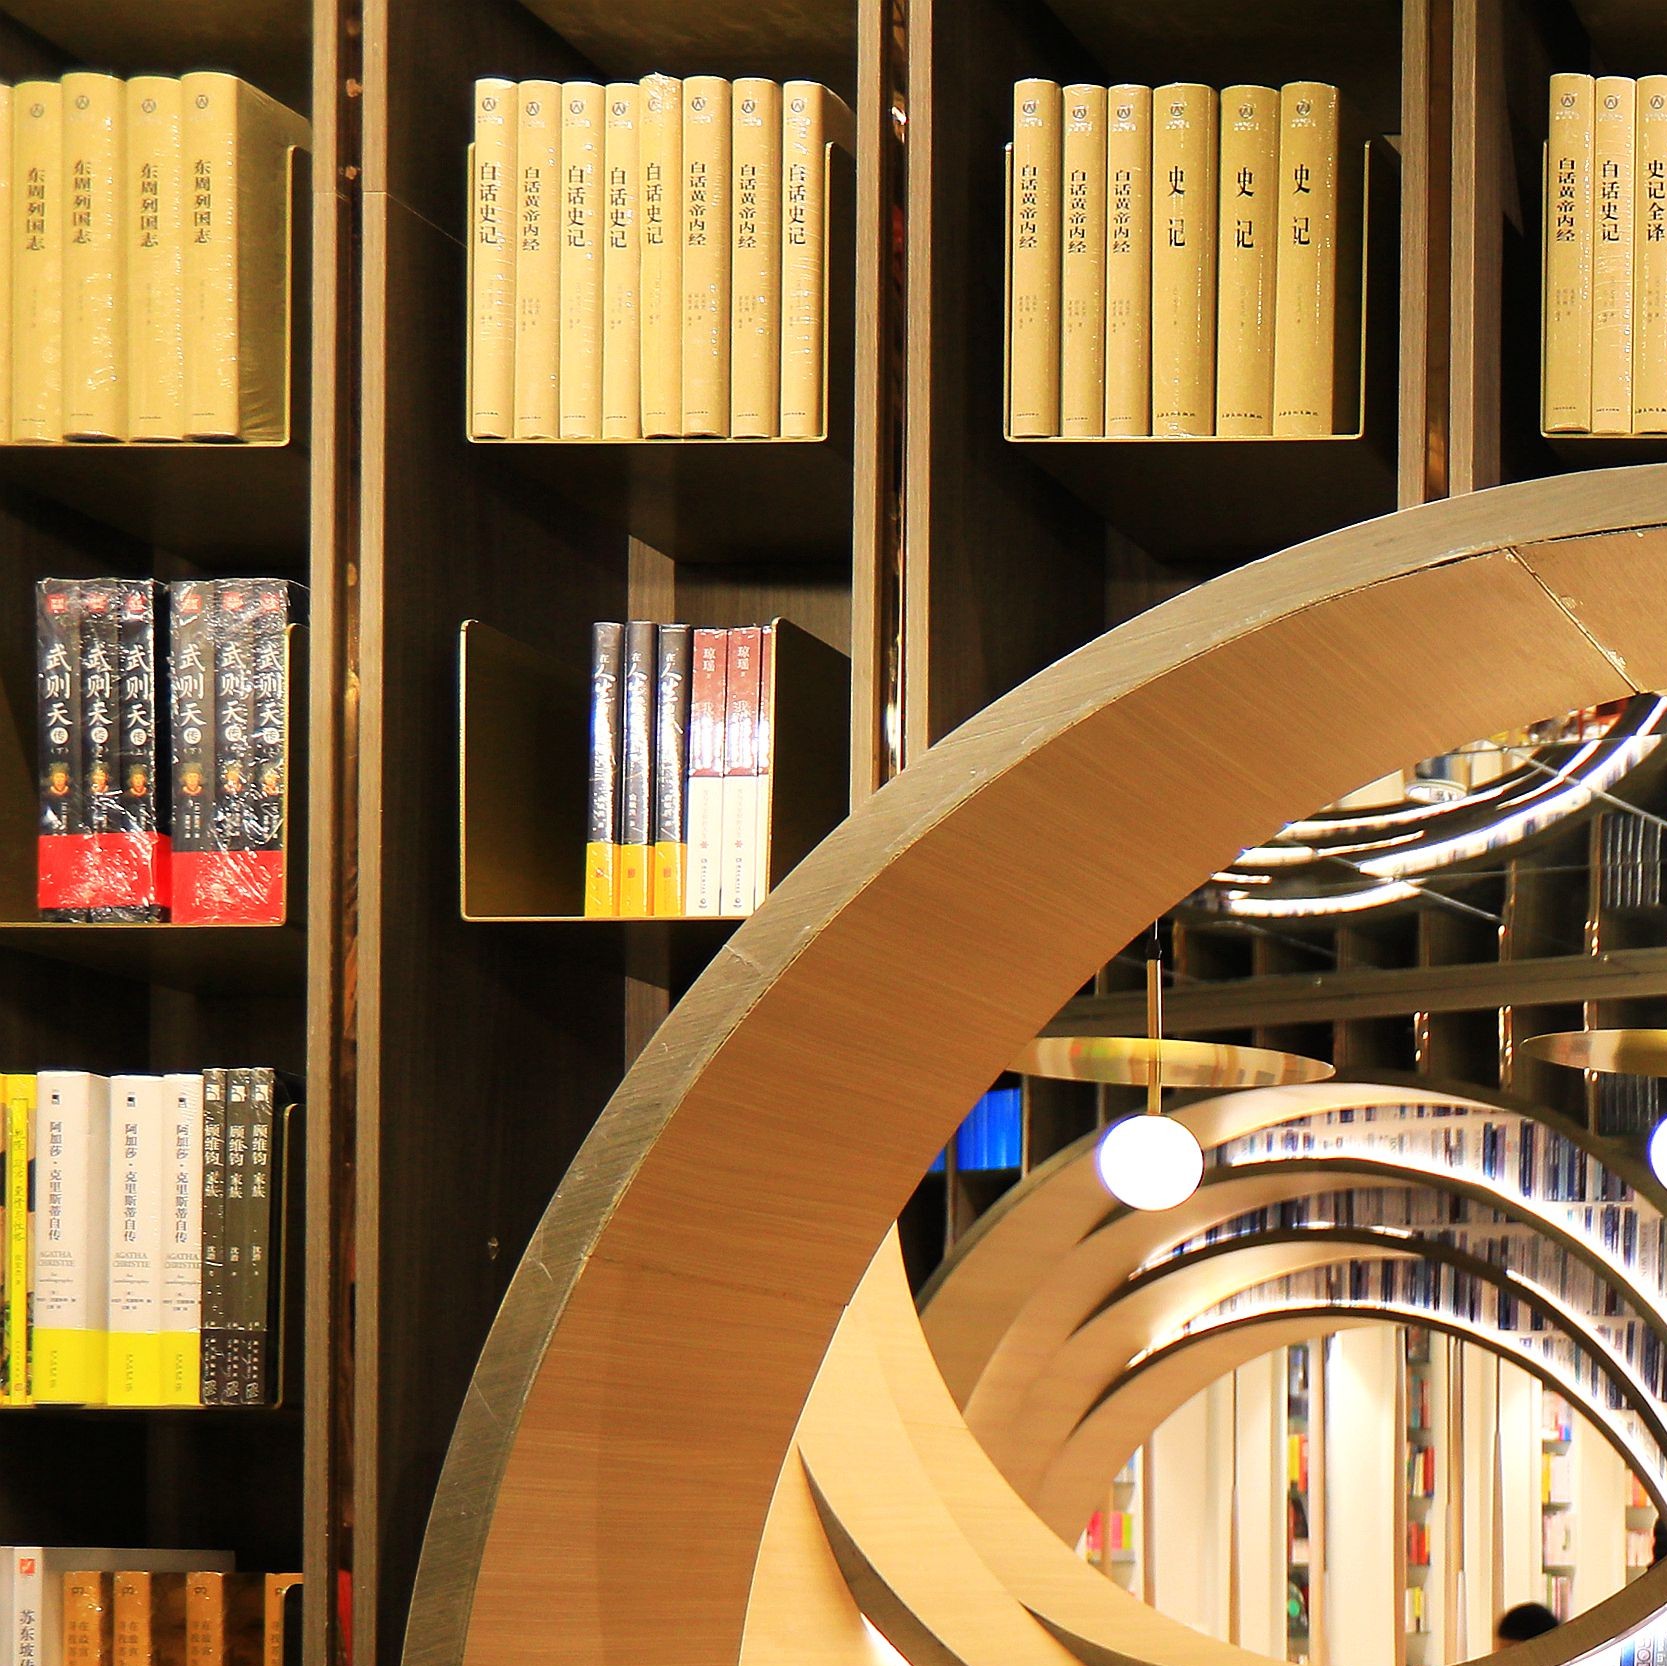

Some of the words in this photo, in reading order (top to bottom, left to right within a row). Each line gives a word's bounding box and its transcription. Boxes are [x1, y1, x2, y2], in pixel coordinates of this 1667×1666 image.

[26, 168, 45, 251] 东周列国志
[72, 160, 92, 244] 东周列国志
[194, 160, 211, 243] 东周列国志
[479, 162, 498, 245] 白话史记
[522, 167, 541, 251] 白话黄帝内经
[567, 165, 586, 248] 白话史记
[738, 165, 757, 248] 白话黄帝内经
[1068, 169, 1088, 254] 白话黄帝内经
[1168, 166, 1186, 248] 史记
[1292, 164, 1311, 246] 史记
[1601, 159, 1620, 242] 白话史记
[1646, 160, 1666, 241] 史记全译
